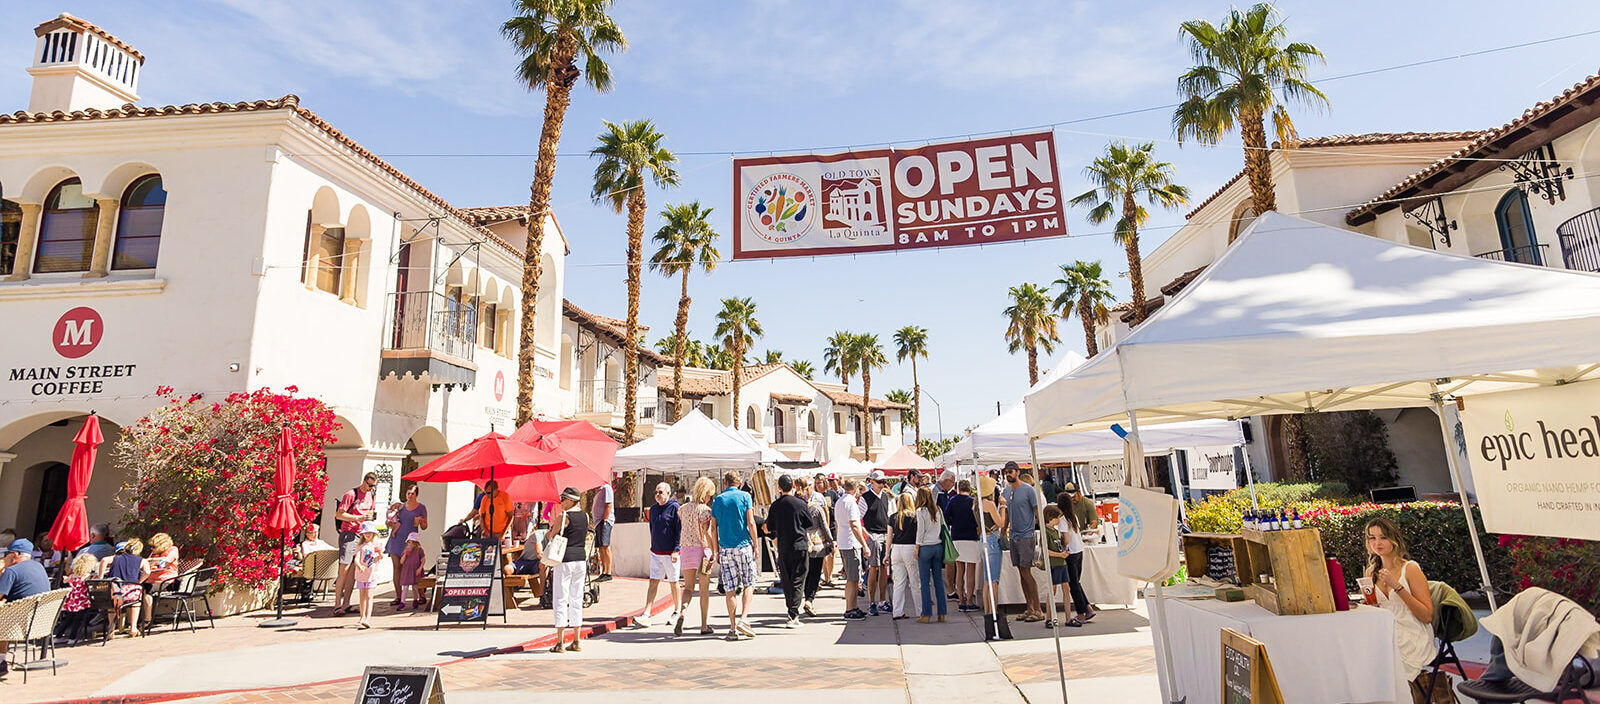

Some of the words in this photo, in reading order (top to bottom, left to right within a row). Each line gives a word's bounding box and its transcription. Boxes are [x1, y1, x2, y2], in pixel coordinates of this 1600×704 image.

[824, 170, 846, 179] OLD
[849, 169, 881, 178] TOWN
[894, 140, 1053, 198] OPEN
[747, 179, 769, 210] CERTIFIED
[769, 174, 801, 184] FARMERS
[799, 180, 816, 207] MARKET
[897, 187, 1057, 224] SUNDAYS
[763, 233, 772, 241] LA
[774, 233, 802, 243] QUINTA
[829, 229, 841, 238] La
[843, 228, 881, 240] Quinta
[899, 229, 949, 244] 8AM
[965, 224, 995, 238] TO
[1011, 217, 1059, 233] 1PM
[60, 319, 94, 346] M
[9, 367, 61, 381] MAIN
[66, 364, 136, 379] STREET
[31, 381, 103, 396] COFFEE
[1480, 431, 1536, 471] epic
[1506, 482, 1541, 493] ORGANIC
[1542, 482, 1565, 493] NANO
[1566, 482, 1589, 493] HEMP
[1537, 501, 1555, 510] HAND
[1555, 501, 1583, 511] CRAFTED
